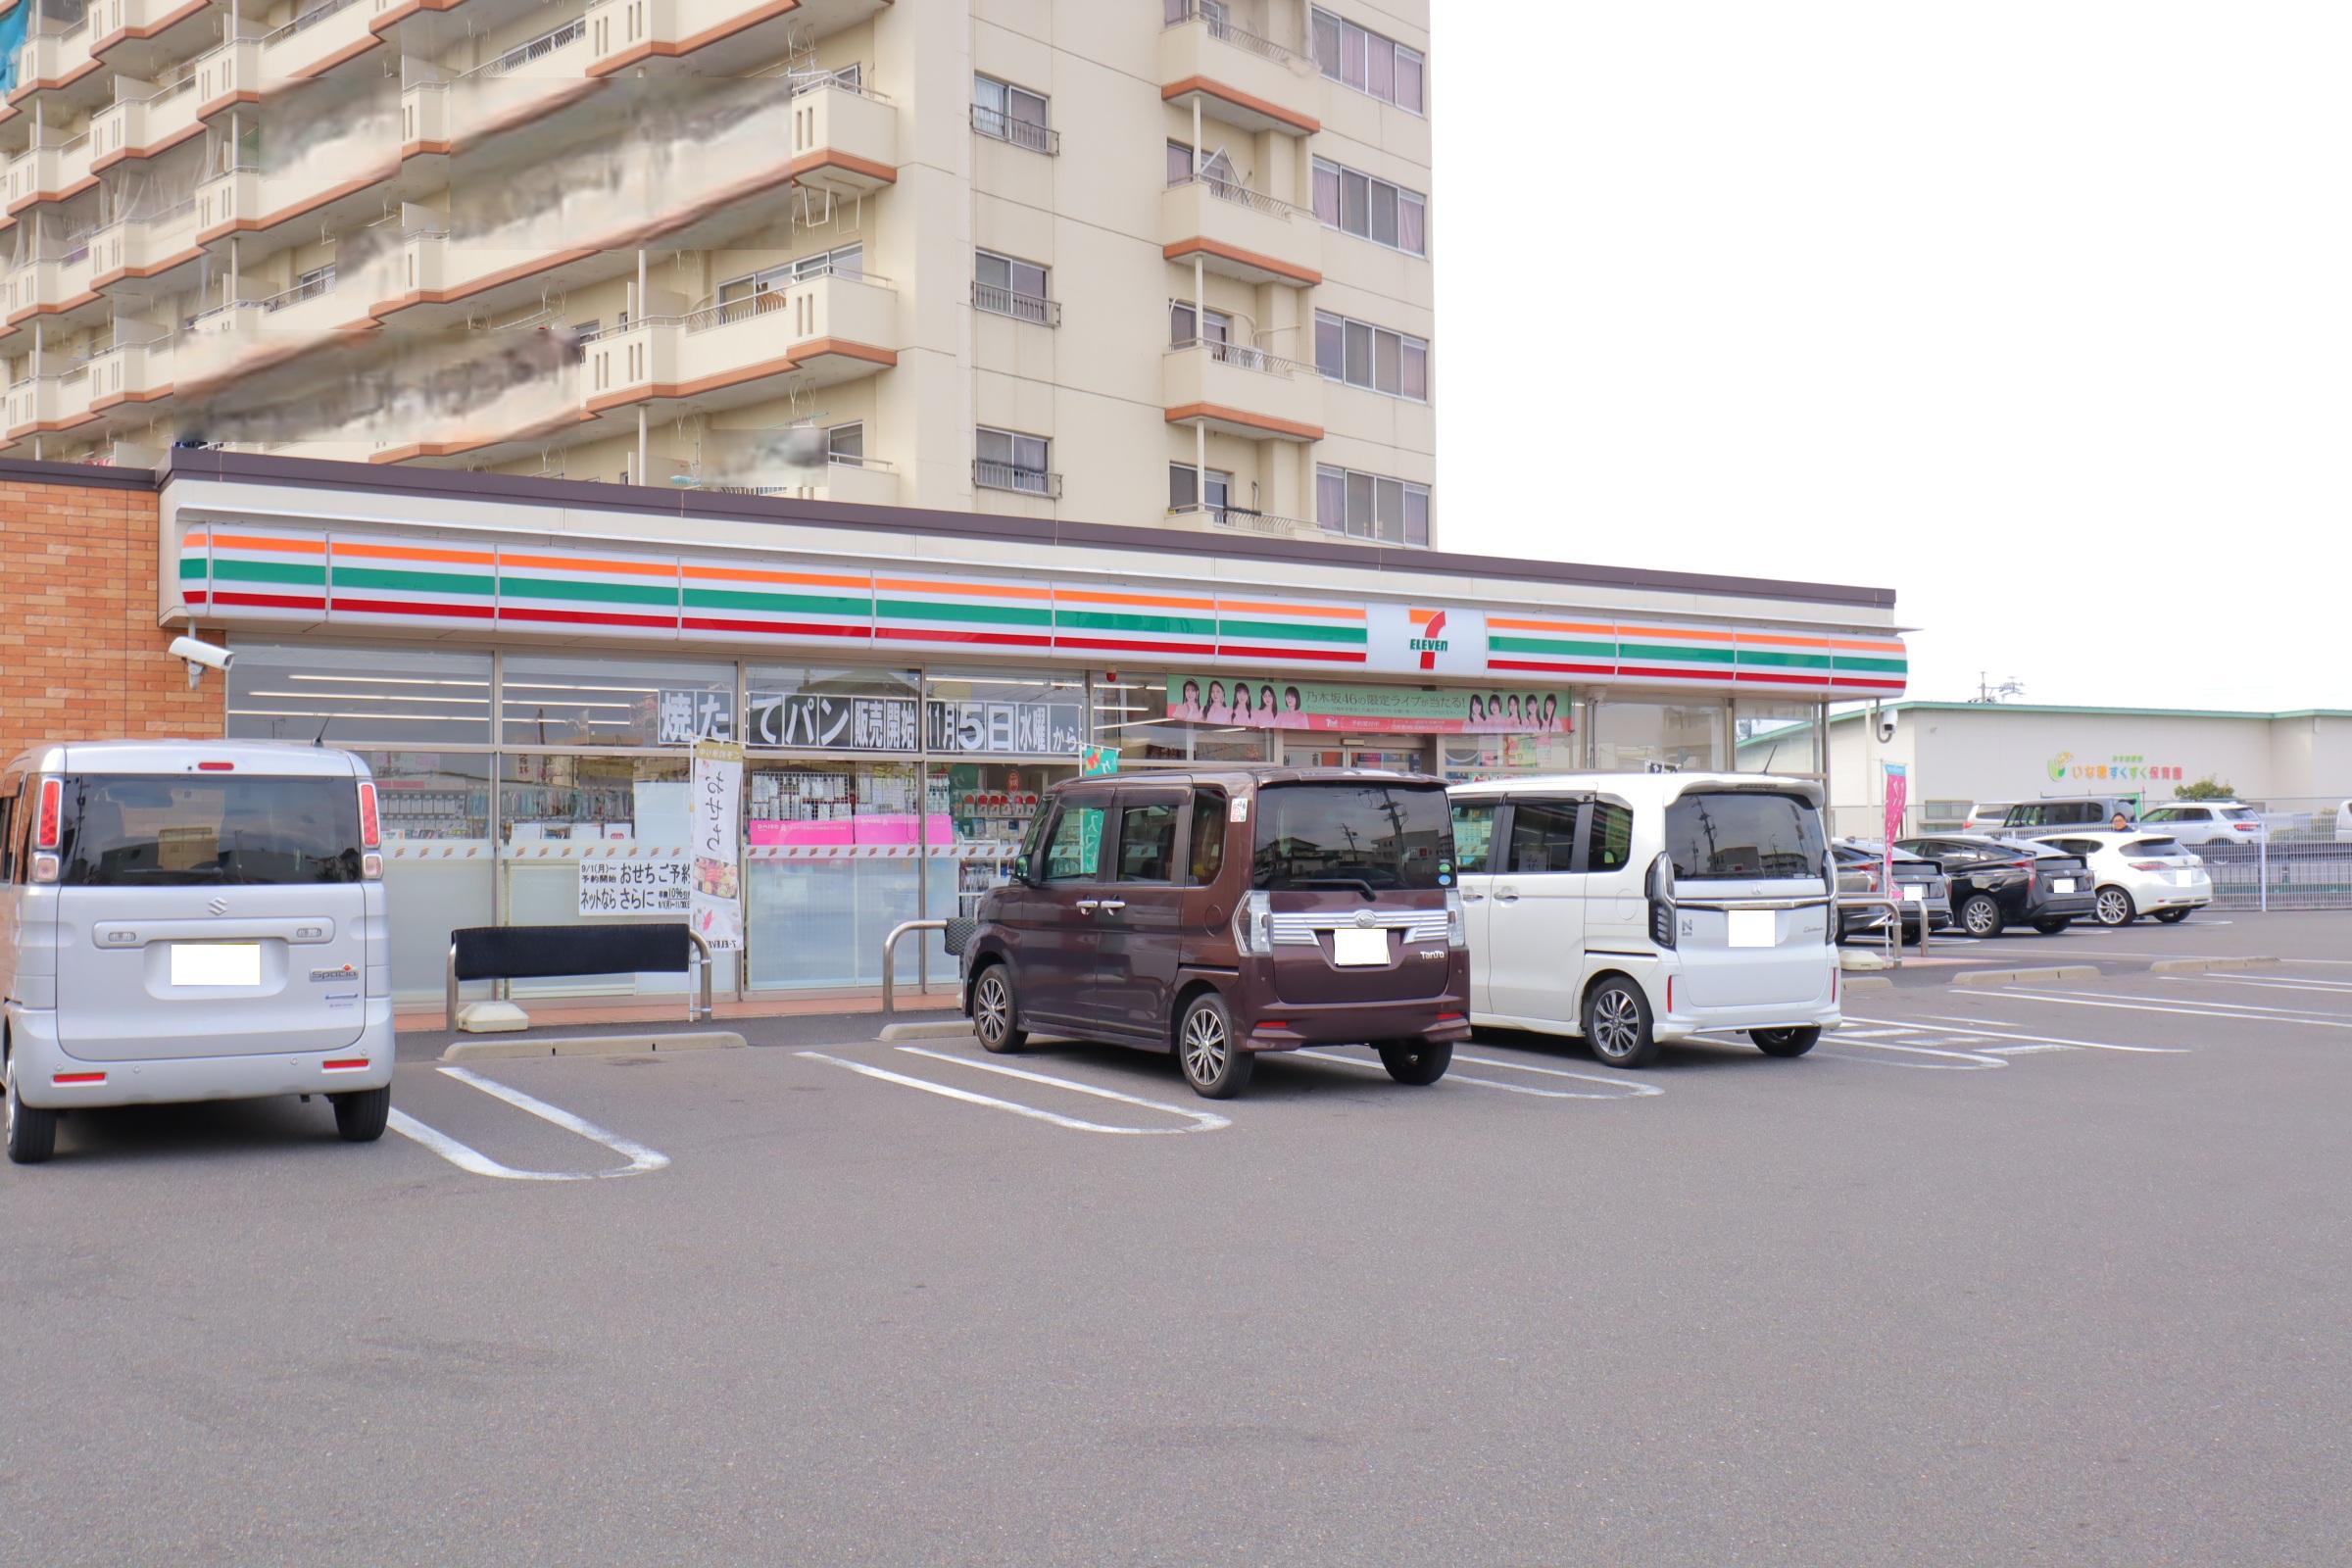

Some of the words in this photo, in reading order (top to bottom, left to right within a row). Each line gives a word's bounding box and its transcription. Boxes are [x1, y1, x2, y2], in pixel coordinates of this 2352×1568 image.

[581, 875, 616, 884] 予約開始
[312, 970, 357, 980] Spacia
